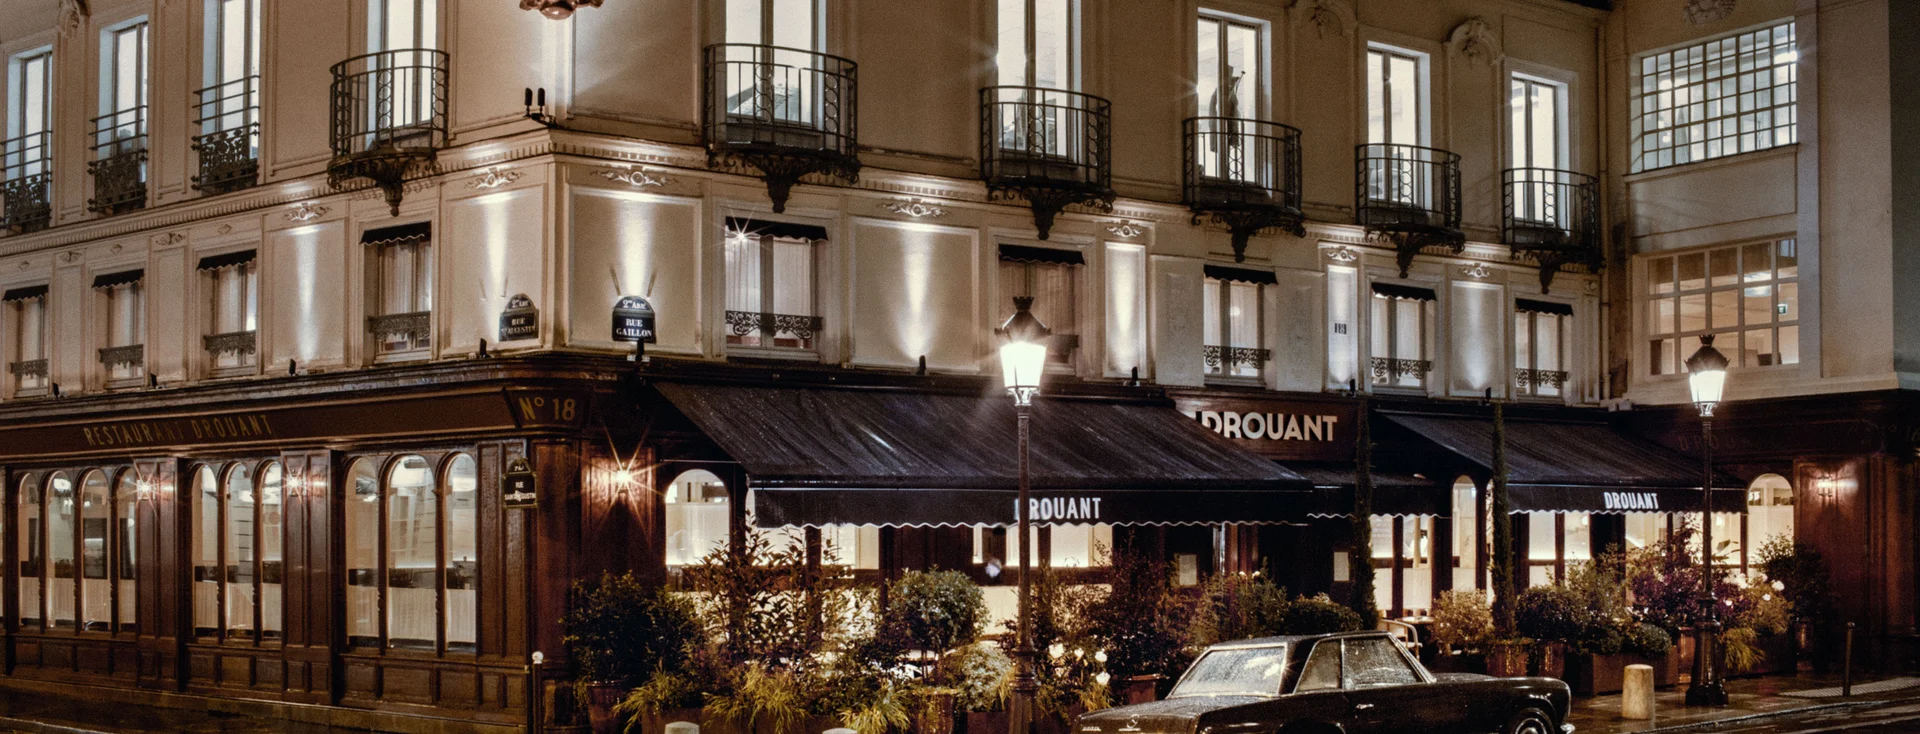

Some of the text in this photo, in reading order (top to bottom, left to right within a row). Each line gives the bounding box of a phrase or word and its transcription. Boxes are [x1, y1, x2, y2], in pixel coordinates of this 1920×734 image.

[615, 327, 652, 337] GAILLON
[625, 318, 643, 327] RUE
[553, 398, 576, 421] 18
[83, 414, 273, 446] RESTAURANT DROUANT
[1201, 410, 1338, 442] DROUANT
[1603, 491, 1660, 510] DROUANT
